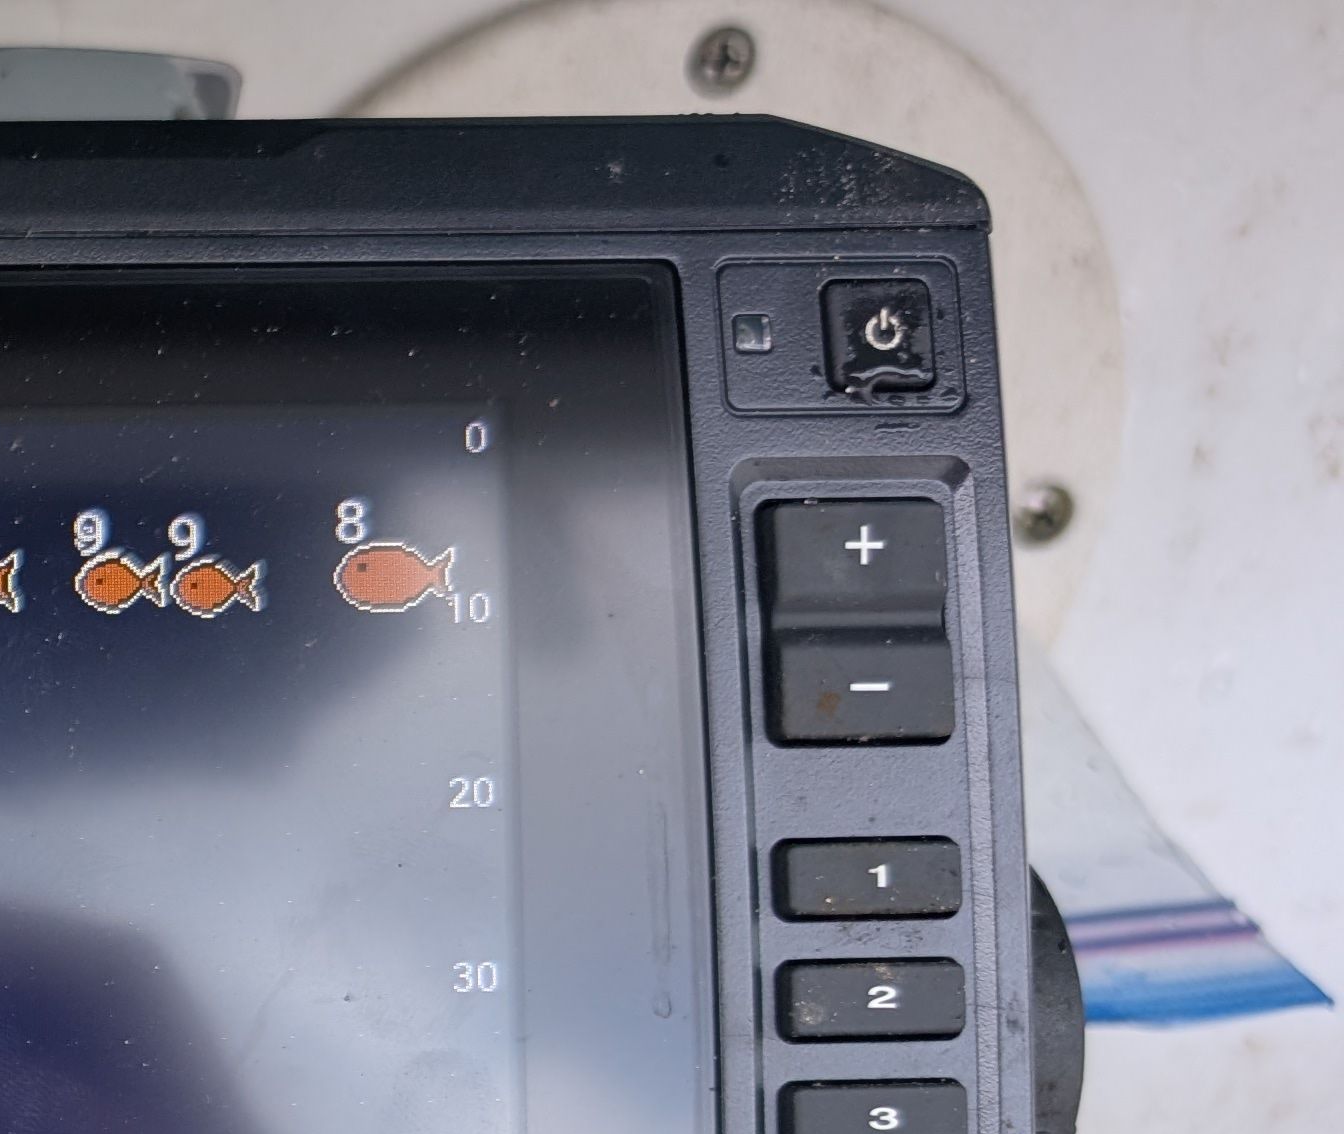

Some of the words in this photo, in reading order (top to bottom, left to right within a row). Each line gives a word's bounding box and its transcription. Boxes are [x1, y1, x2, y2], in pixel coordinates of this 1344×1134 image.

[465, 422, 487, 452] 0
[74, 511, 108, 555] 9
[169, 516, 203, 559] 9
[335, 500, 366, 544] 8
[446, 592, 490, 624] 10
[448, 776, 496, 808] 20
[867, 863, 891, 889] 1
[452, 961, 499, 994] 30
[867, 985, 898, 1010] 2
[869, 1106, 900, 1130] 3
